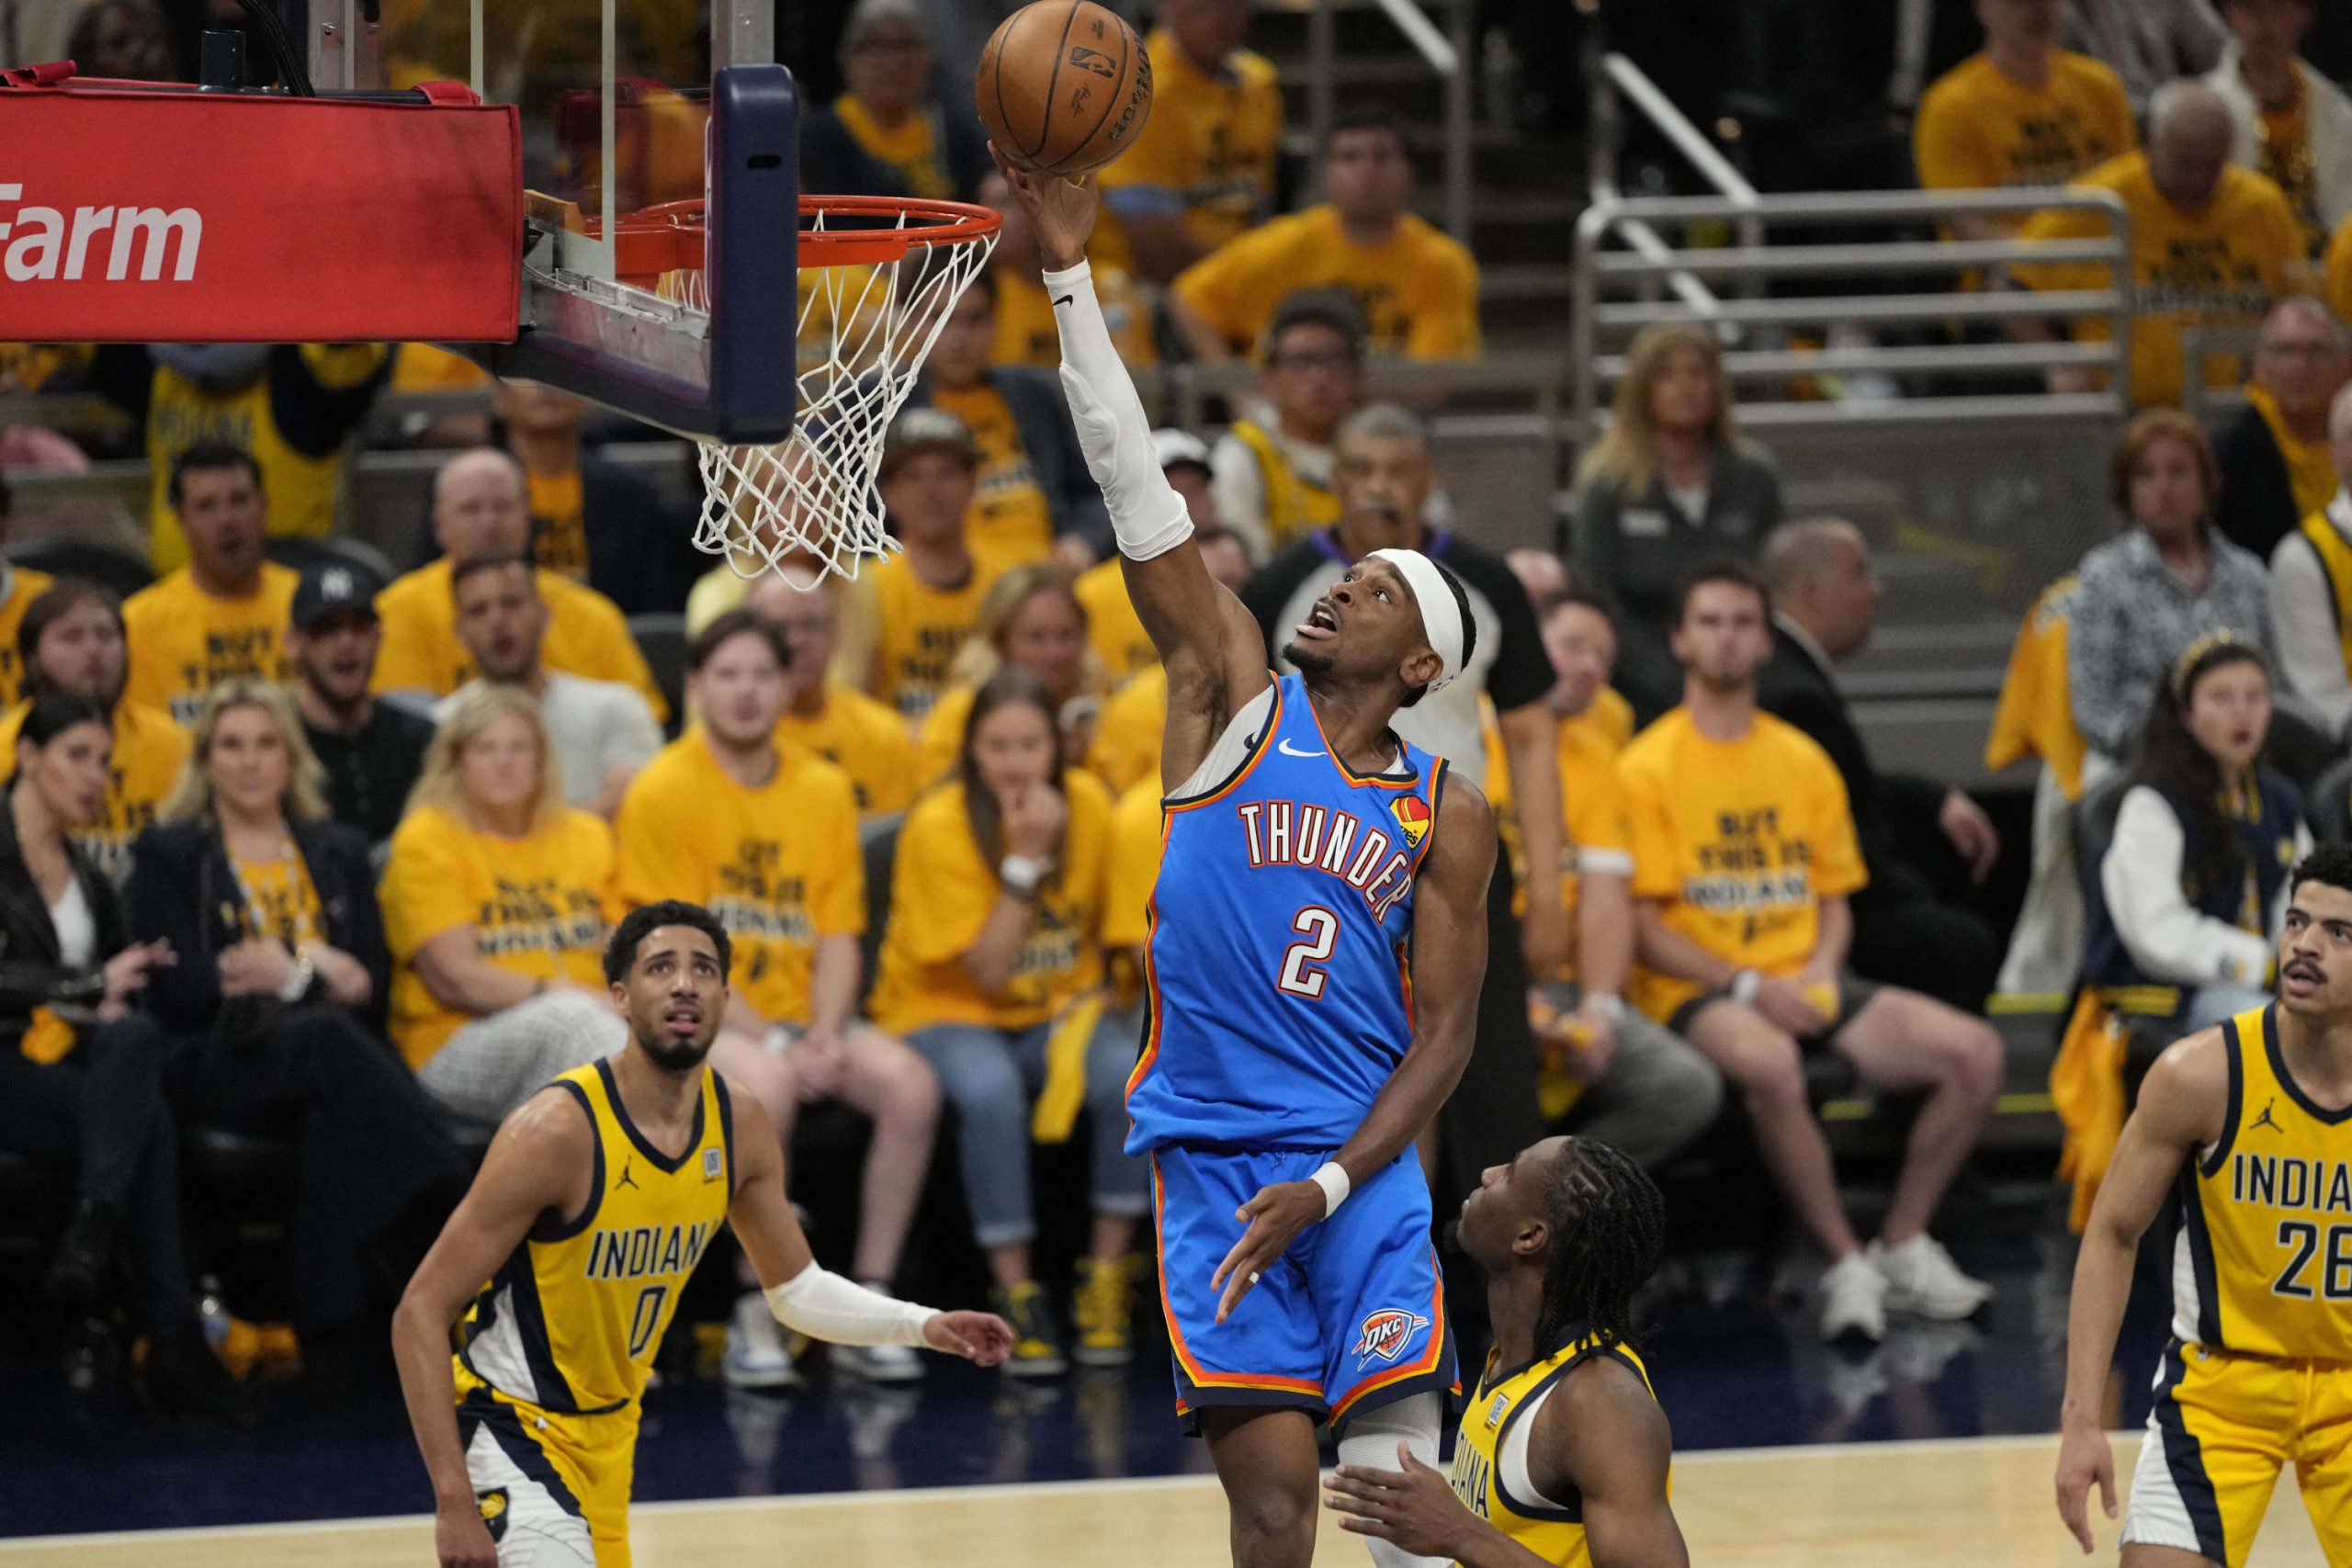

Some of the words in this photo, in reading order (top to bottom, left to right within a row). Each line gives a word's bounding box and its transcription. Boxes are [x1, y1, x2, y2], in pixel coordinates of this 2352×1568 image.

[1237, 799, 1413, 927] THUNDER
[1276, 904, 1340, 1000] 2
[2271, 1219, 2352, 1302] 26
[628, 1285, 668, 1359] 0
[1363, 1317, 1402, 1357] OKC
